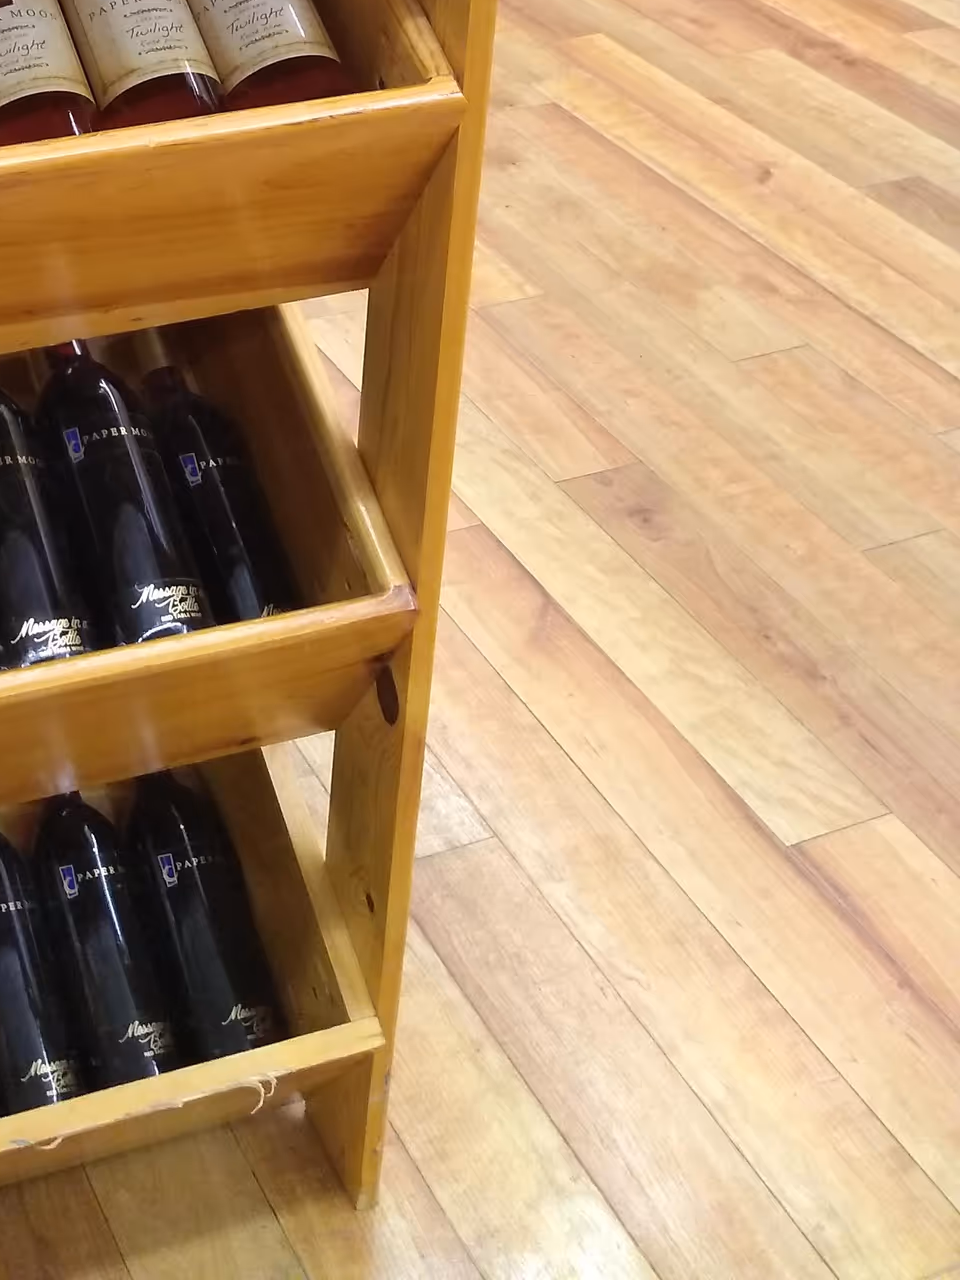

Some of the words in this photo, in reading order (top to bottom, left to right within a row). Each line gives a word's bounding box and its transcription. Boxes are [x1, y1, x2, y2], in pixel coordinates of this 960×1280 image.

[227, 5, 285, 36] Twilight
[126, 22, 185, 40] Twilight
[82, 426, 129, 446] PAPER
[131, 583, 189, 609] Message
[155, 595, 199, 613] Bottle
[11, 617, 70, 644] Message
[72, 616, 83, 629] in
[34, 628, 82, 649] Bottle
[77, 865, 116, 883] PAPER
